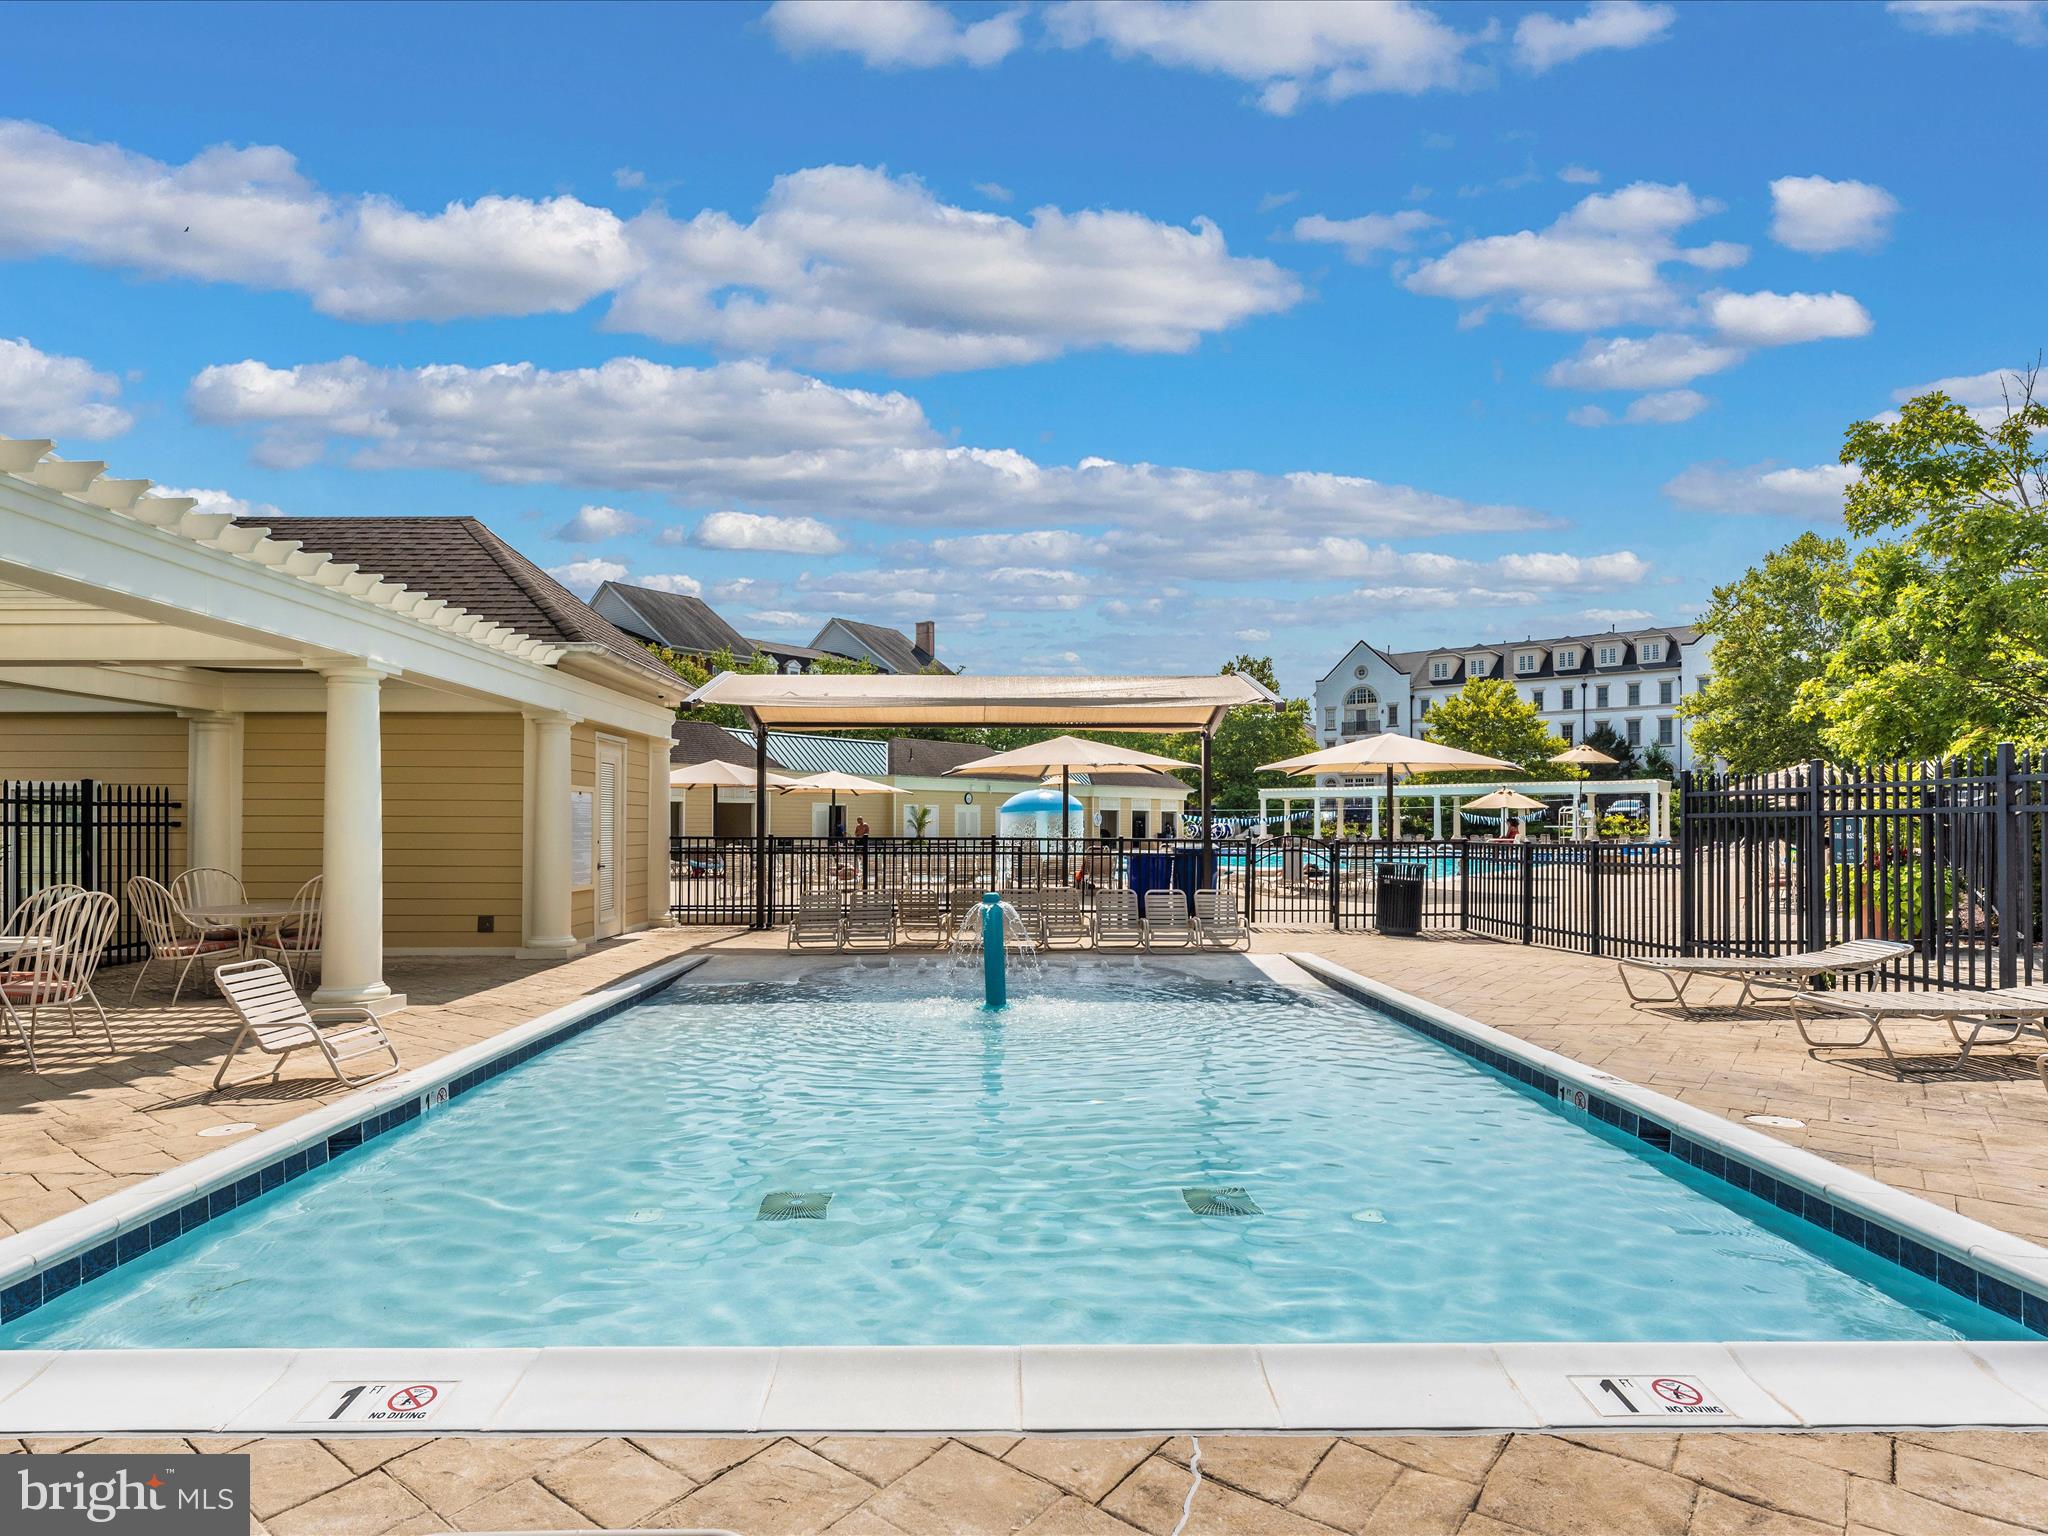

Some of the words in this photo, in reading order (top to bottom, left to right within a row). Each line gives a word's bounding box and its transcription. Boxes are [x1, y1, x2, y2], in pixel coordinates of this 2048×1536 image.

[426, 1093, 430, 1110] 1
[1560, 1086, 1565, 1101] 1
[1618, 1378, 1634, 1388] FT
[328, 1385, 367, 1420] 1
[369, 1385, 386, 1394] FT
[1599, 1379, 1640, 1413] 1
[1666, 1405, 1683, 1413] NO
[1683, 1405, 1724, 1414] DIVING
